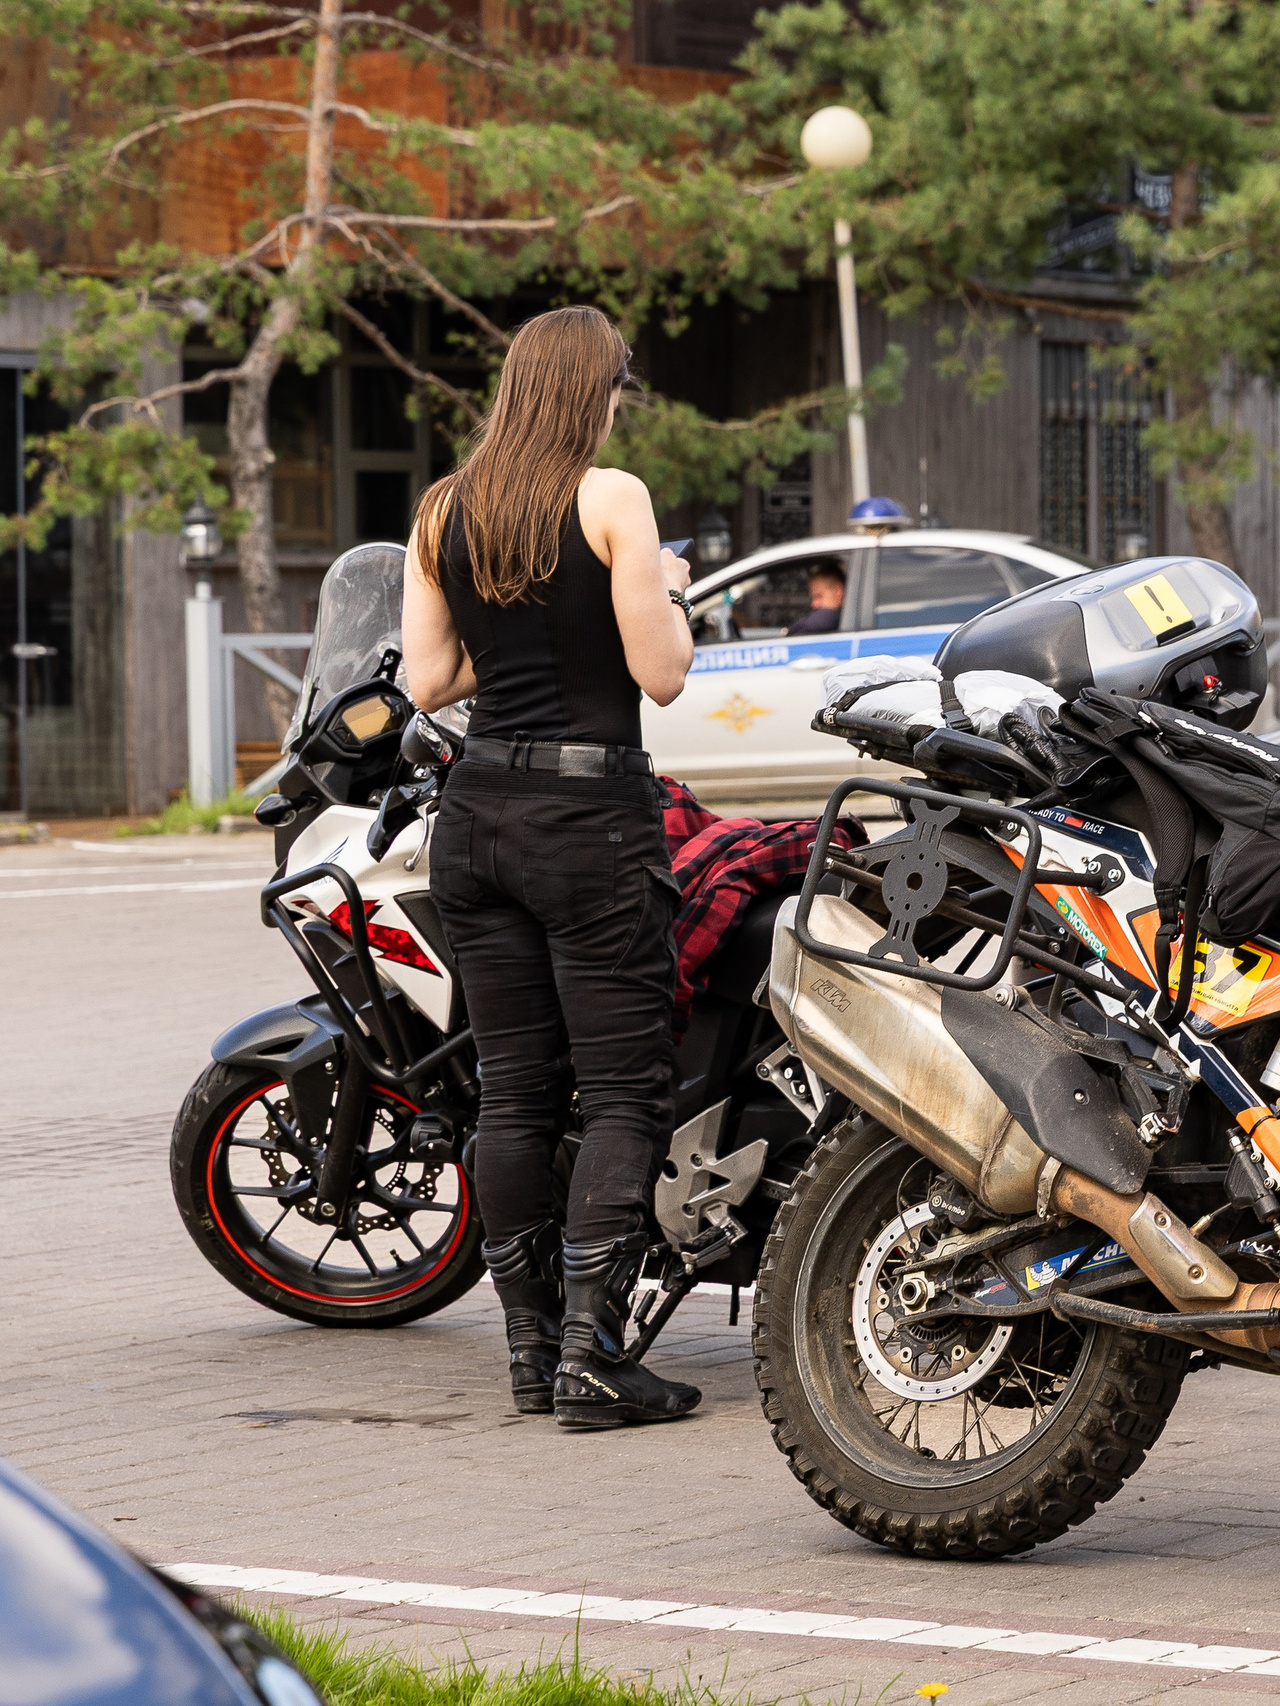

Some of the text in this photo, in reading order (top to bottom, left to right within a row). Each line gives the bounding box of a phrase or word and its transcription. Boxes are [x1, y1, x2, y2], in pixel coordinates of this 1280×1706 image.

[1028, 808, 1106, 835] ADY TO RACE
[1067, 909, 1107, 958] MOTOREX
[810, 978, 851, 1013] KTM
[941, 1199, 967, 1217] brembo
